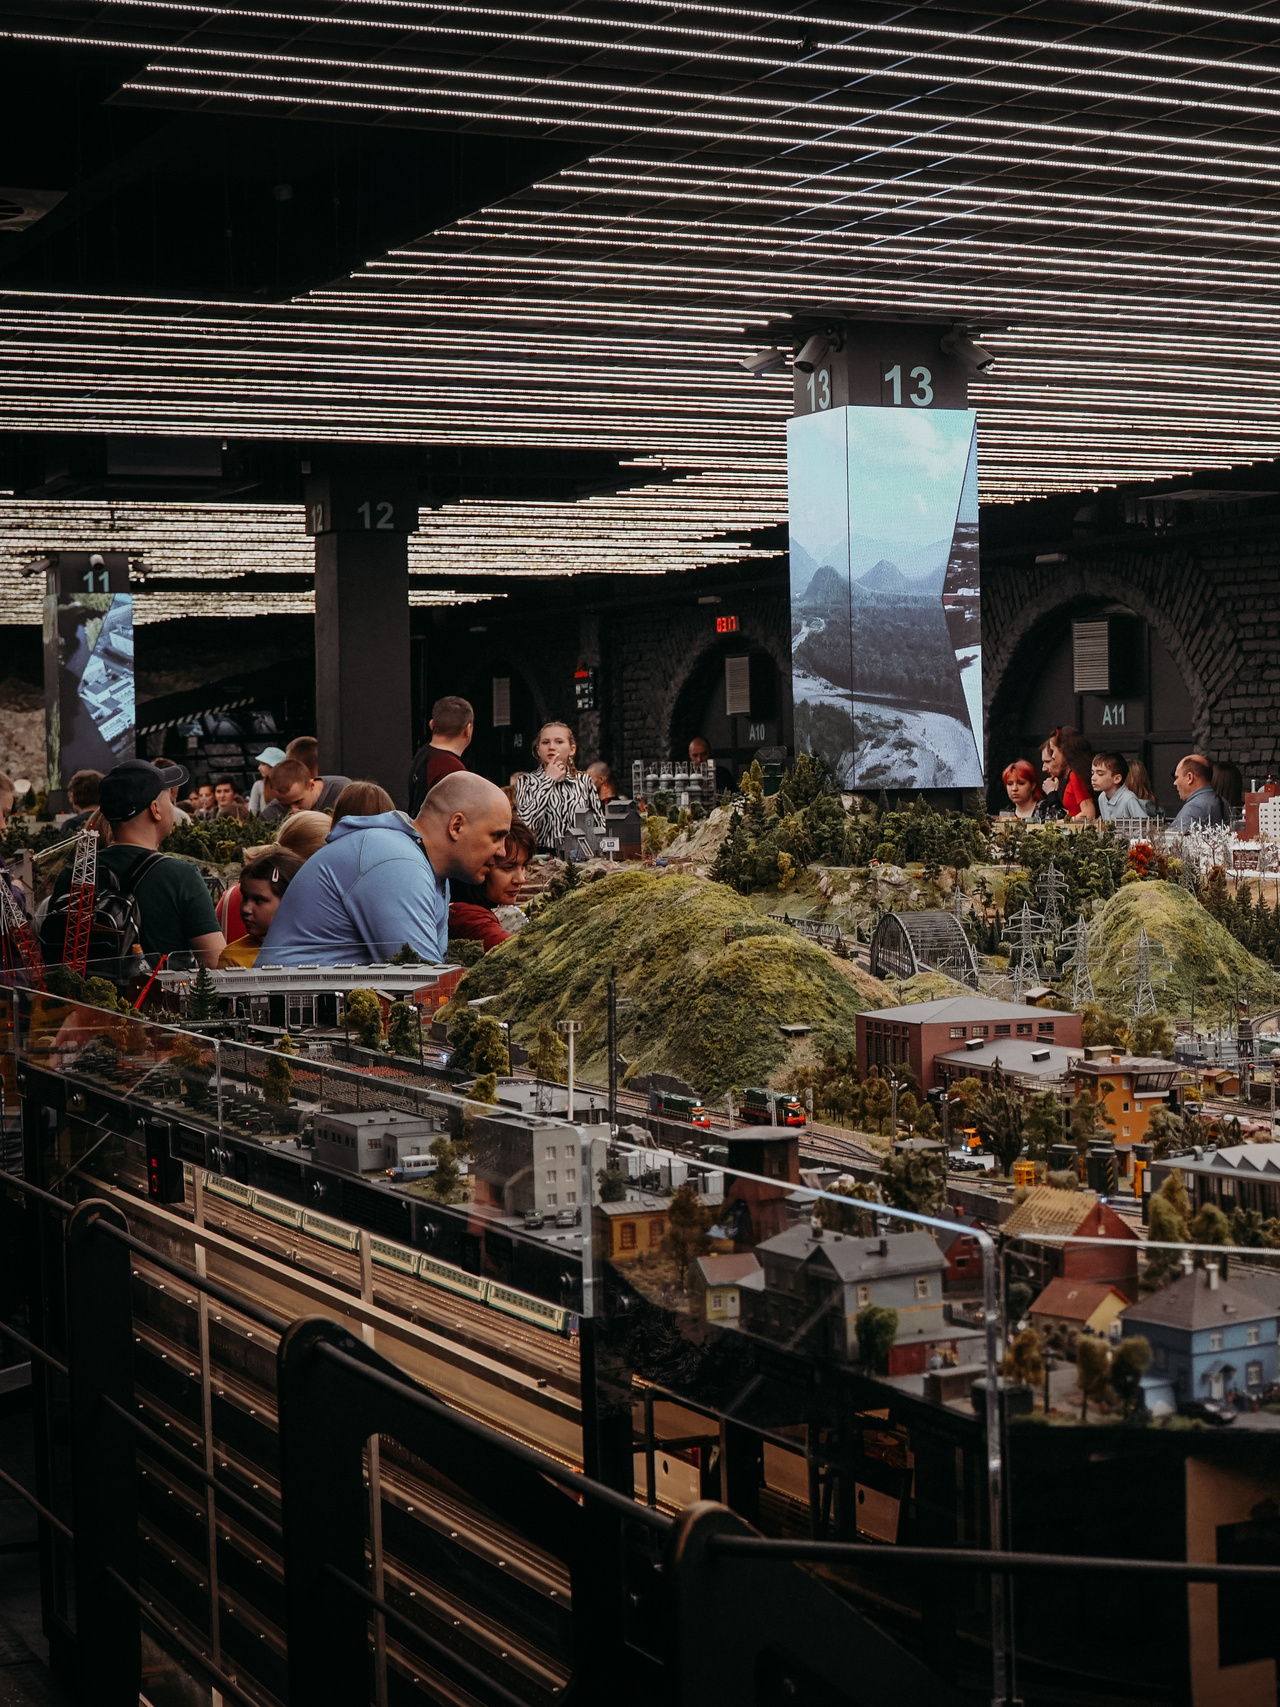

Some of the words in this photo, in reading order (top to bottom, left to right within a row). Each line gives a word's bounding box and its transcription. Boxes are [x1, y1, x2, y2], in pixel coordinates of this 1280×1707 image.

[806, 369, 831, 412] 13
[884, 365, 934, 407] 13
[311, 503, 324, 531] 12
[358, 501, 394, 529] 12
[82, 570, 110, 593] 11
[1102, 704, 1125, 725] A11
[749, 723, 765, 741] A10
